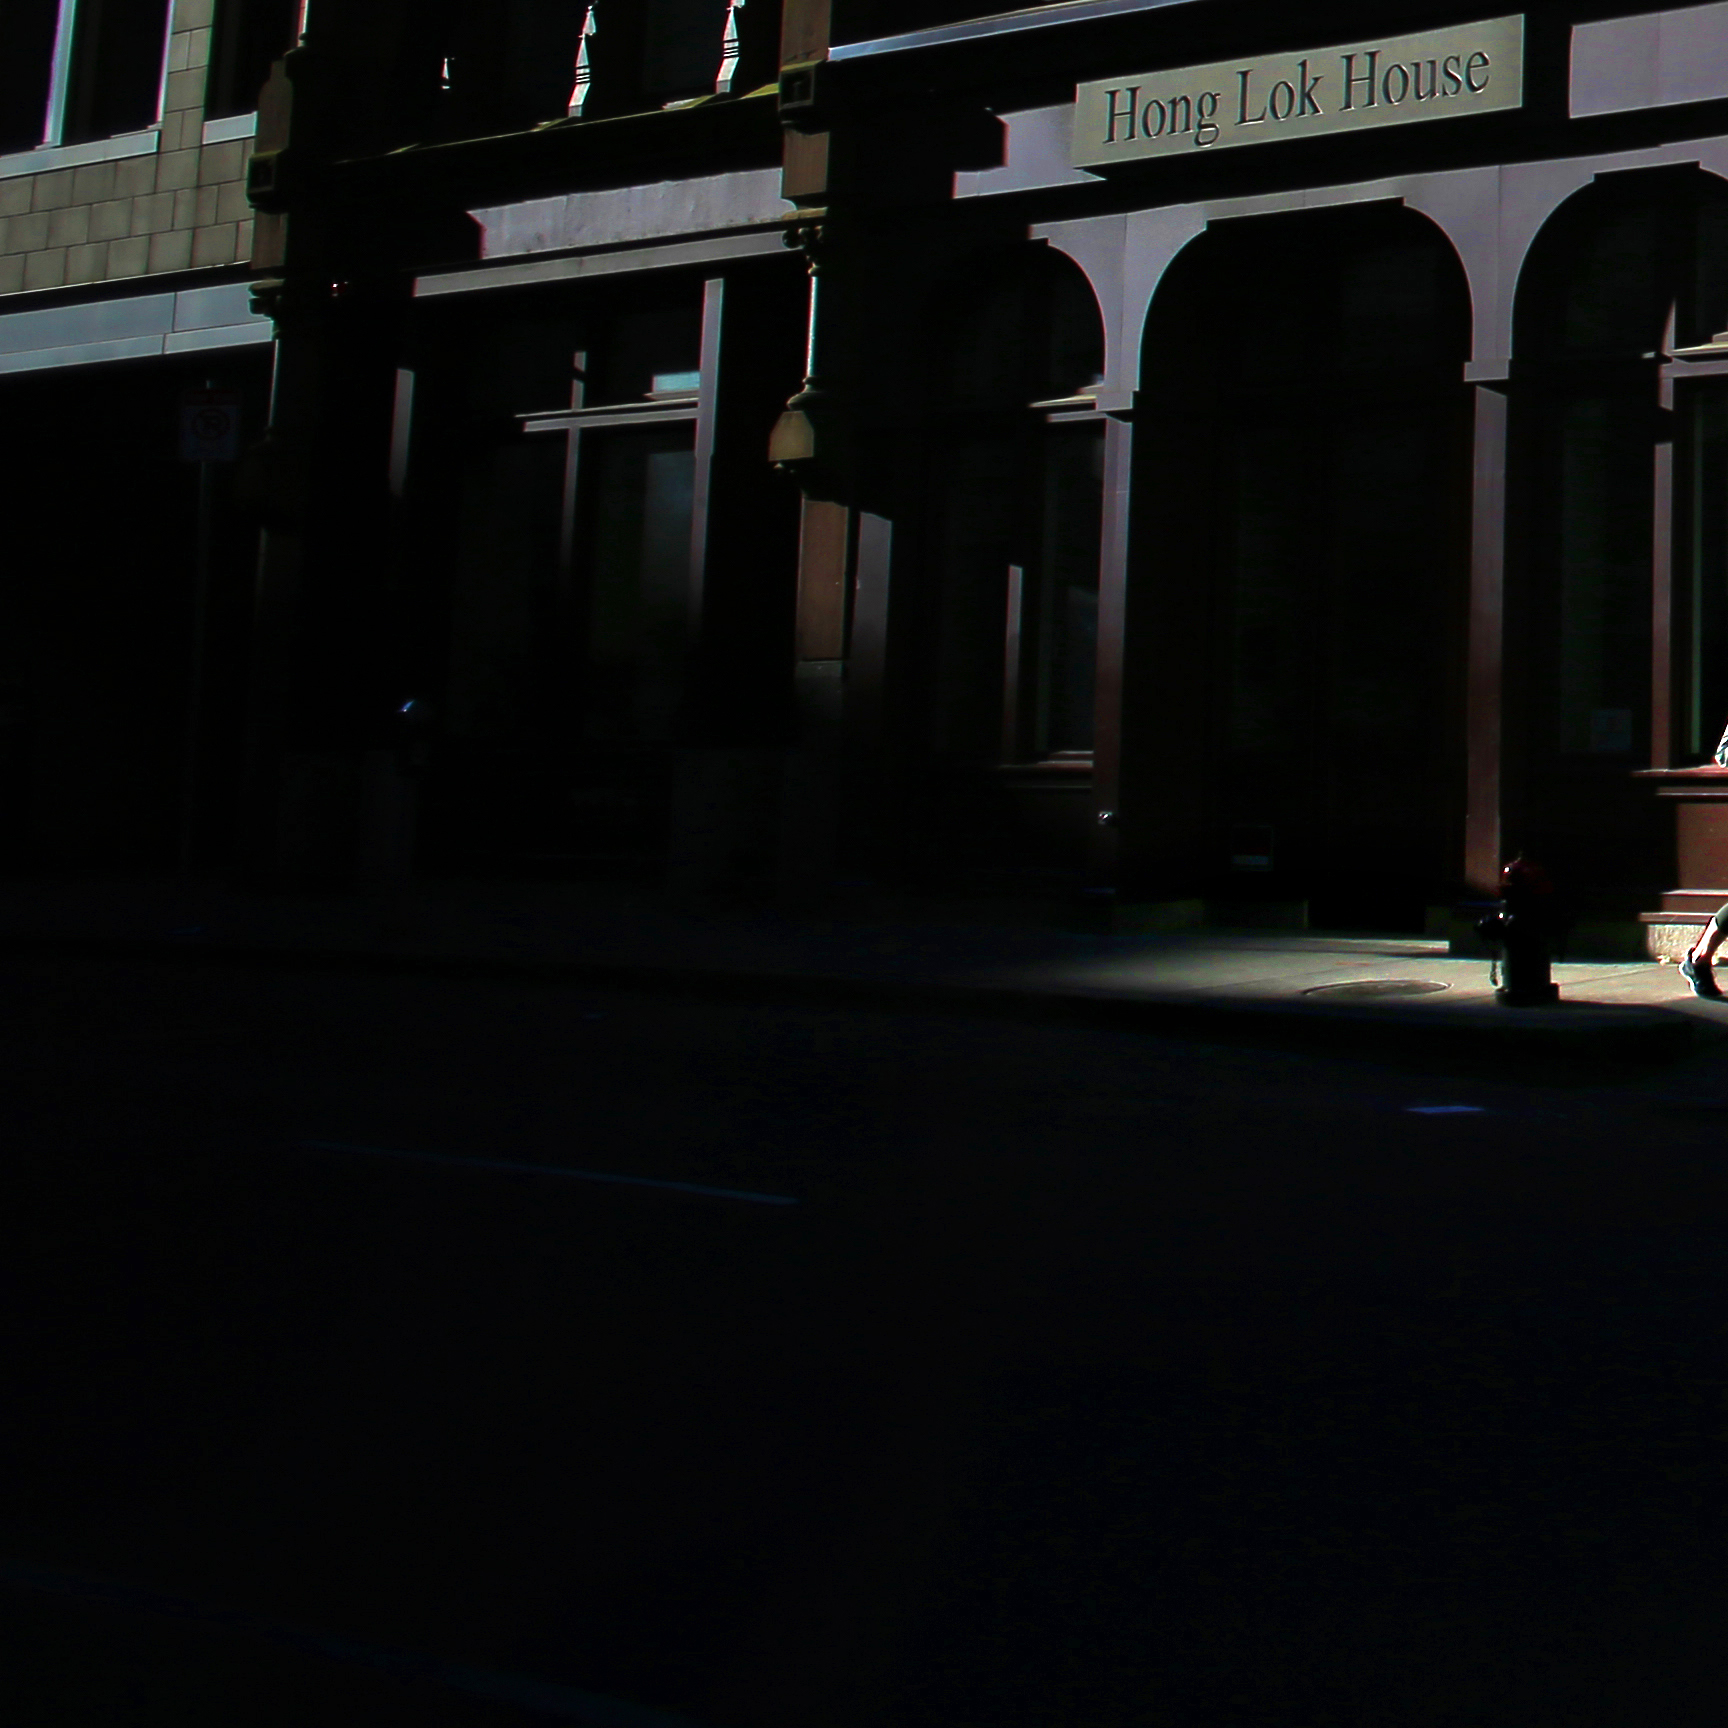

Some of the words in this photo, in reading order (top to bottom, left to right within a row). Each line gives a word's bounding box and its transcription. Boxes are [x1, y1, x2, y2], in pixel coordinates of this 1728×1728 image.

[1102, 85, 1221, 147] Hong
[1234, 59, 1324, 126] Lok
[1338, 49, 1491, 112] House
